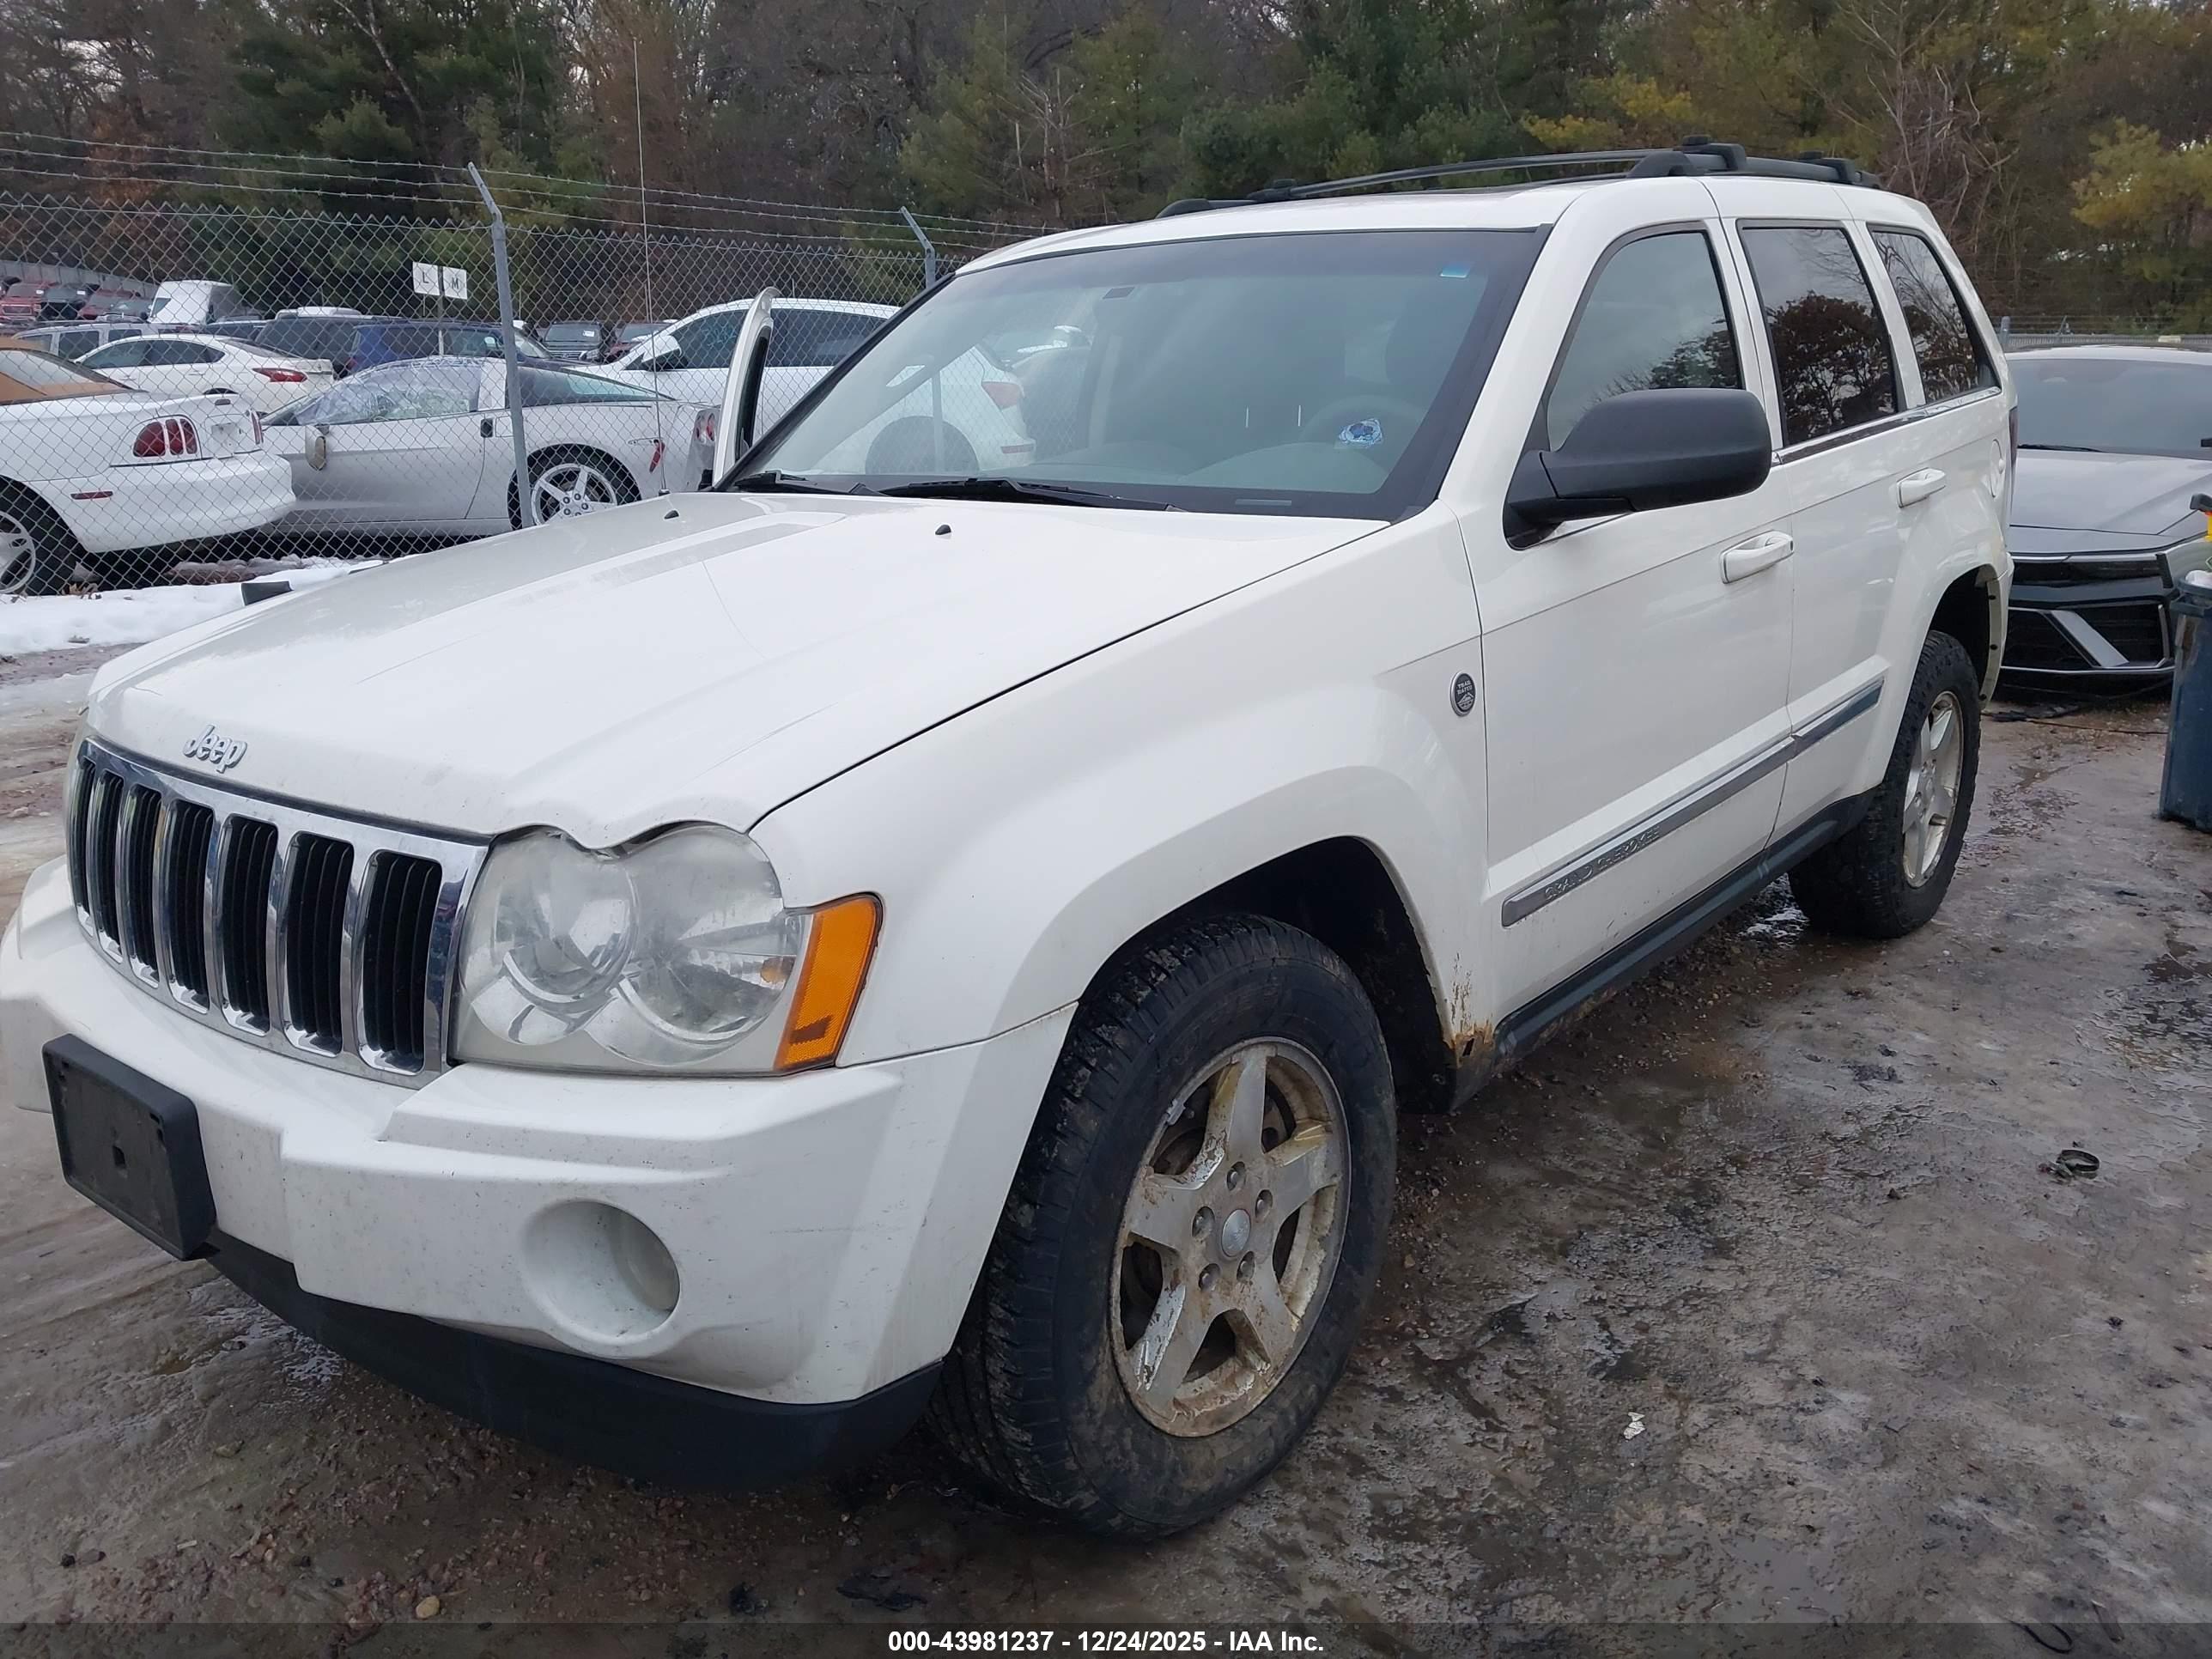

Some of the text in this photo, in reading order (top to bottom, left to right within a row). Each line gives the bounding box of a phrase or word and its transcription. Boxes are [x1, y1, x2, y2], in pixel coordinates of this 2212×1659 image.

[422, 271, 429, 284] L
[452, 276, 459, 289] M
[183, 724, 248, 775] Jeep
